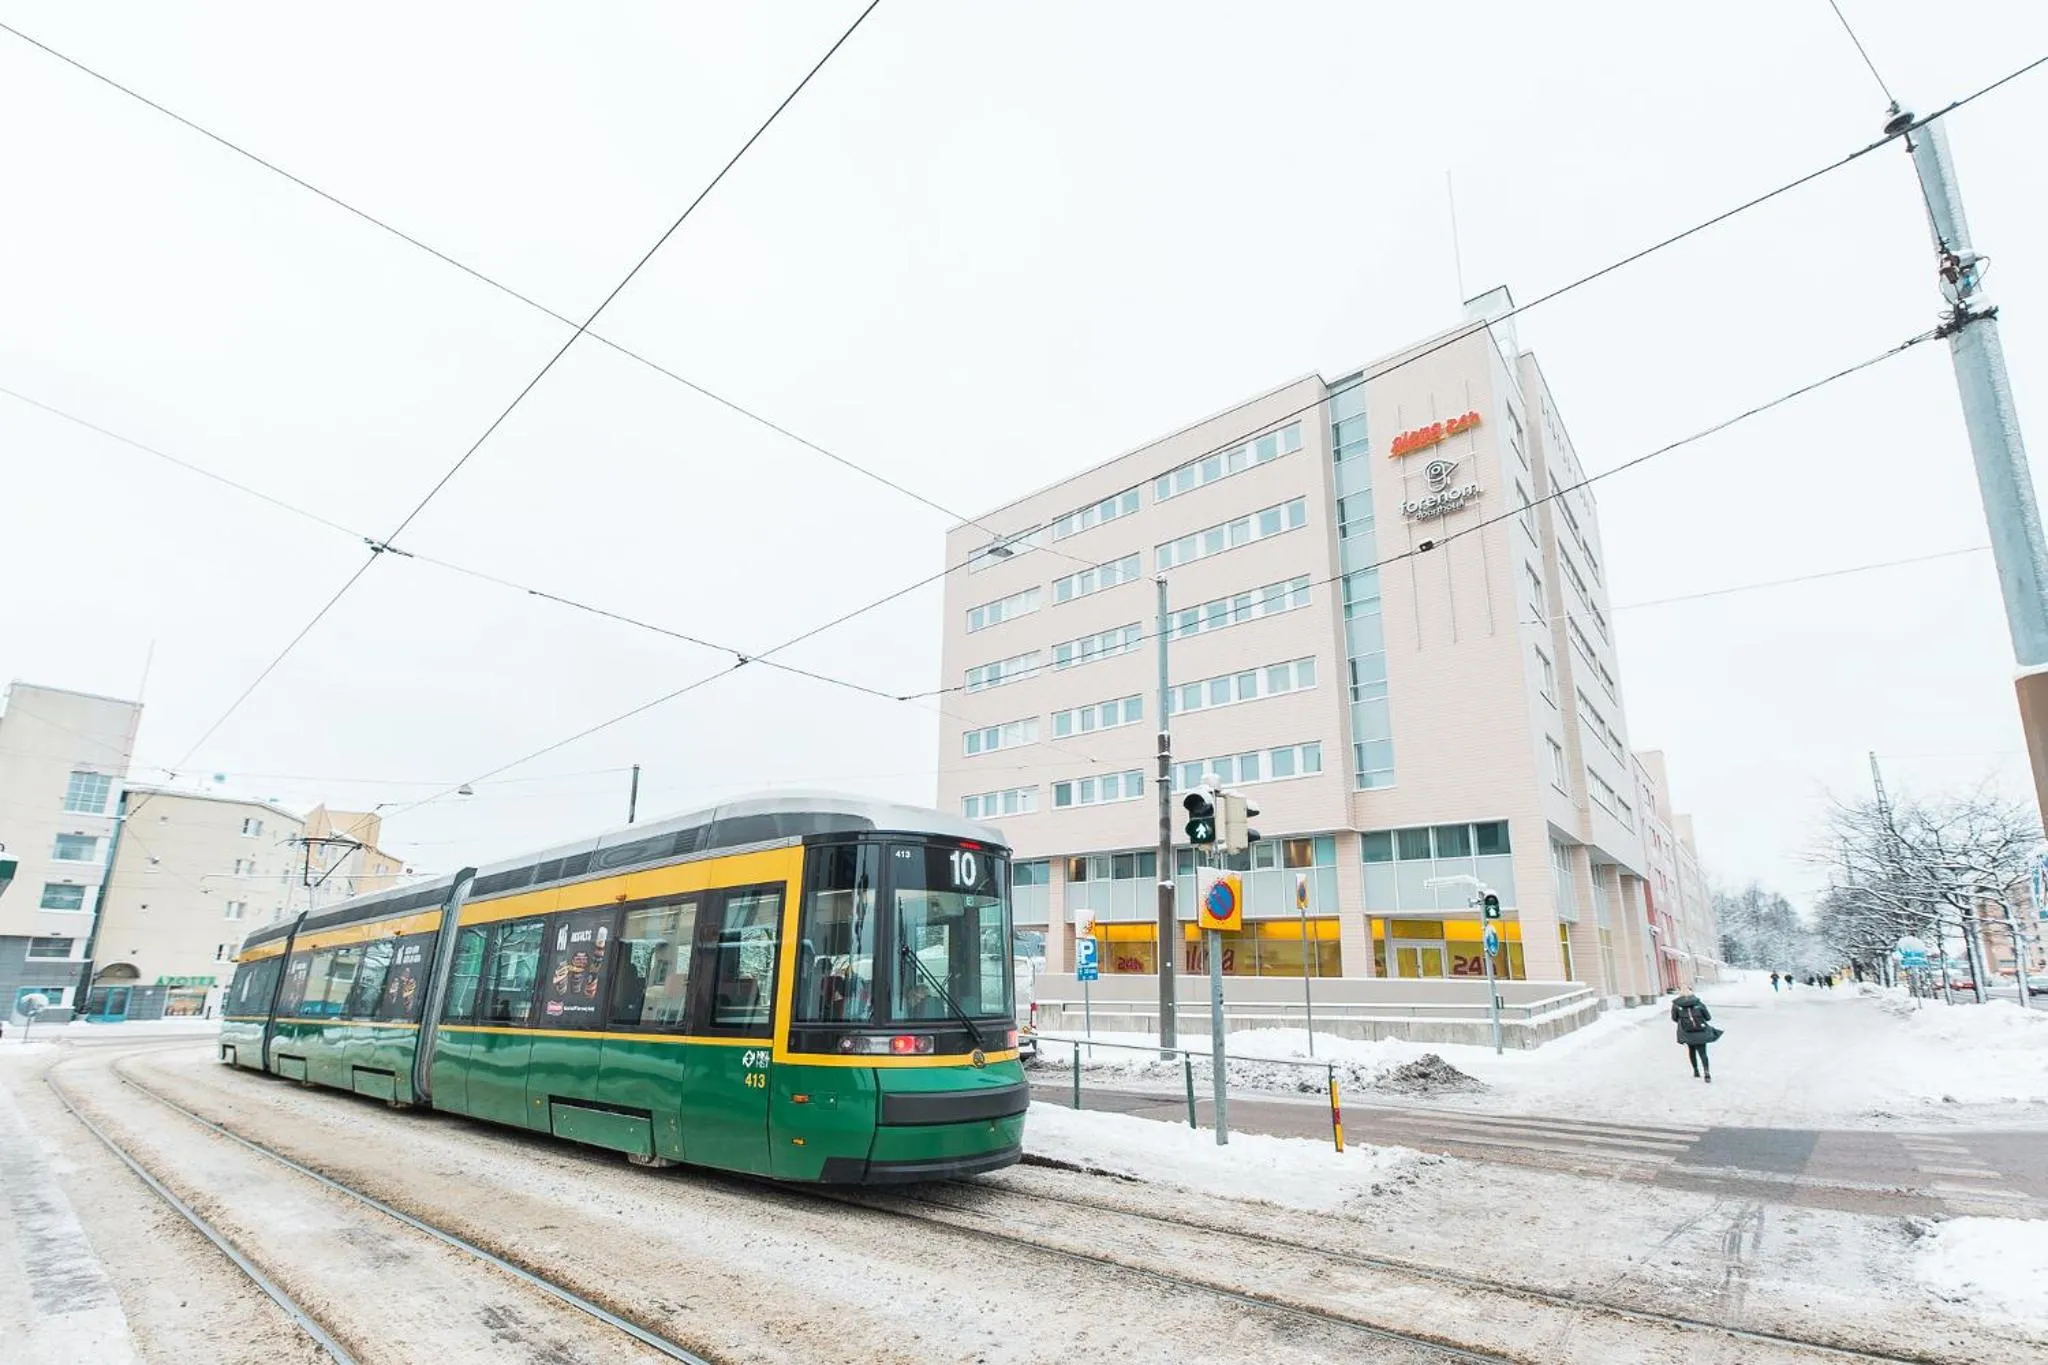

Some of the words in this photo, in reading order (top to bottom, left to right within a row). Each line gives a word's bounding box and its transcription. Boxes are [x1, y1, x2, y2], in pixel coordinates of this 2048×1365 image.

[1400, 483, 1477, 515] forenom
[895, 850, 911, 859] 413
[949, 850, 977, 887] 10
[1079, 941, 1094, 965] P
[744, 1072, 766, 1089] 413
